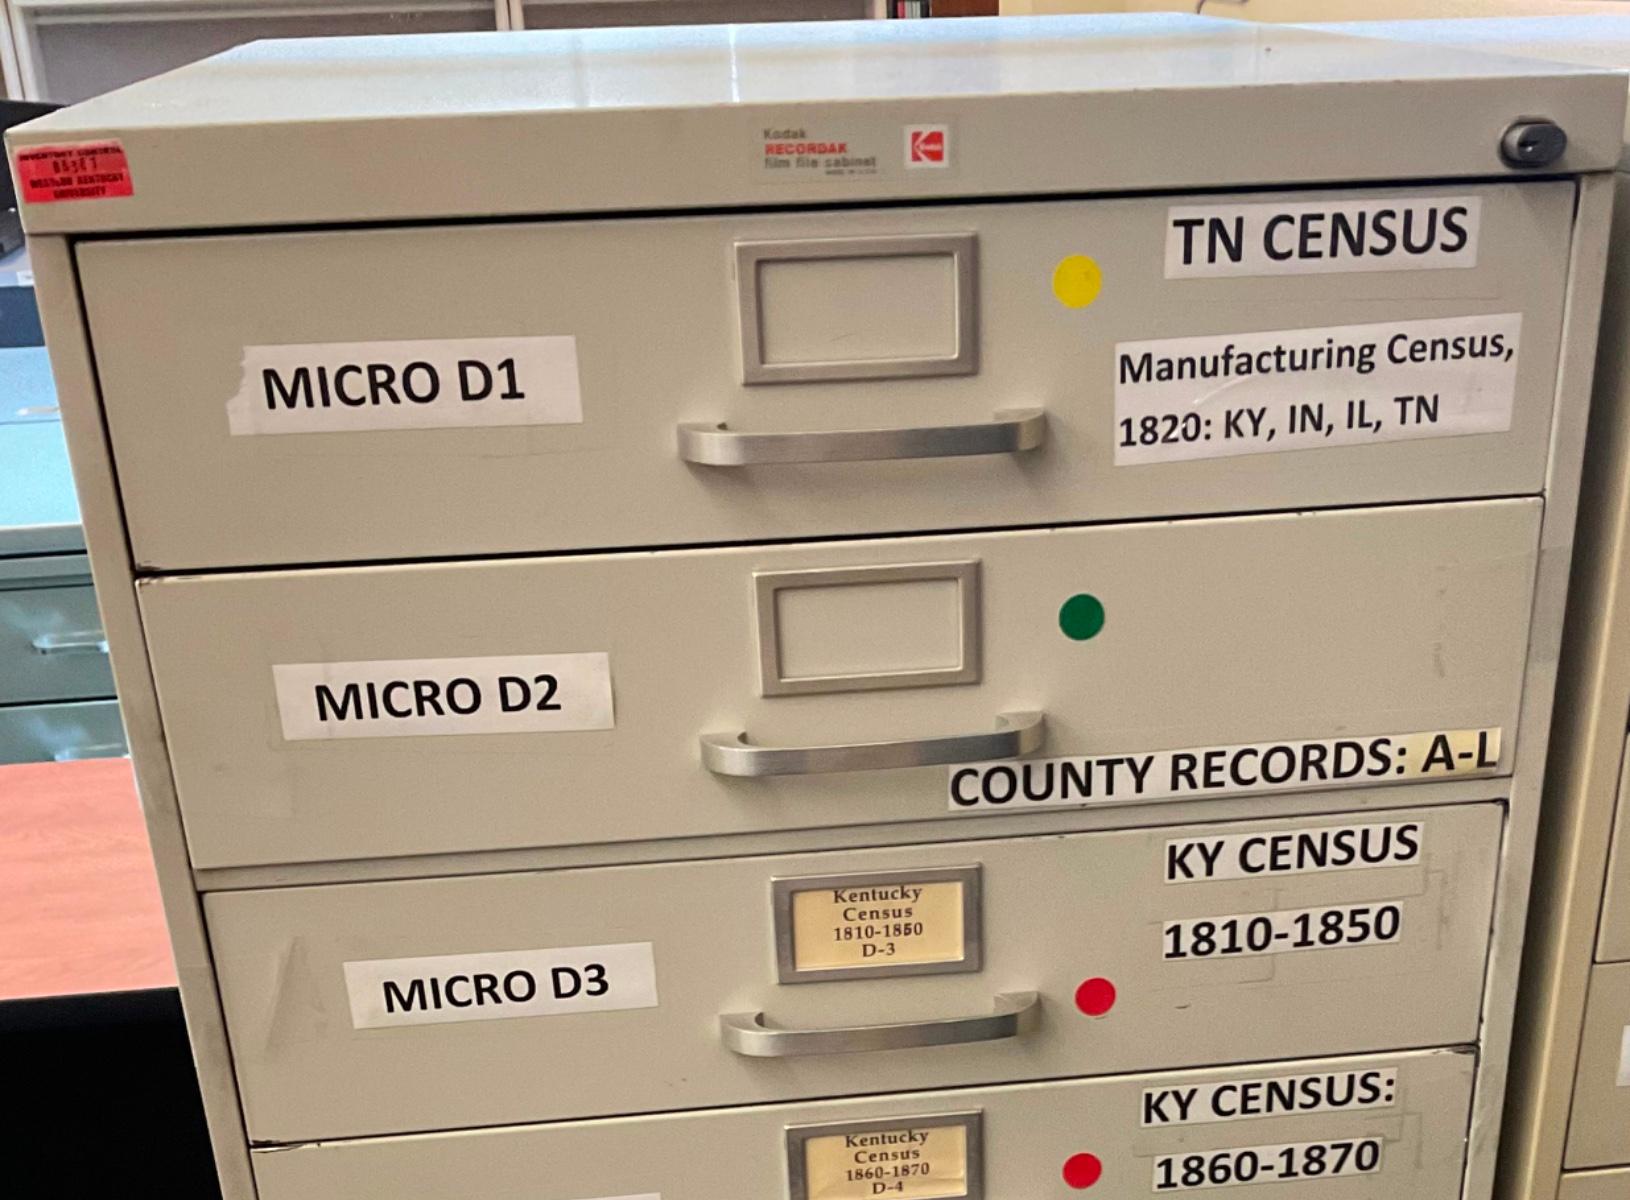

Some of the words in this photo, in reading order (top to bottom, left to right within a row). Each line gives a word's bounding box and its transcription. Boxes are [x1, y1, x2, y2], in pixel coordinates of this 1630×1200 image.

[764, 128, 805, 139] Kodak
[765, 143, 847, 155] RECORDAK
[1173, 216, 1244, 265] TN
[1263, 206, 1468, 261] CENSUS
[1119, 338, 1376, 385] Manufacturing
[1387, 333, 1515, 365] Census,
[262, 361, 440, 410] MICRO
[458, 358, 525, 401] D1
[1119, 412, 1212, 447] 1820:
[1224, 407, 1276, 441] KY,
[1288, 403, 1334, 437] IN,
[1347, 399, 1382, 433] IL,
[1394, 394, 1439, 424] TN
[315, 678, 481, 721] MICRO
[498, 674, 561, 712] D2
[950, 755, 1154, 807] COUNTY
[1170, 737, 1407, 792] RECORDS:
[1422, 730, 1497, 773] A-L
[1167, 840, 1225, 881] KY
[1238, 824, 1419, 874] CENSUS
[833, 886, 922, 903] Kentucky
[843, 907, 913, 922] Census
[862, 943, 895, 957] D-3
[1164, 905, 1400, 959] 1810-1850
[383, 970, 536, 1013] MICRO
[551, 963, 609, 999] D3
[1143, 1088, 1198, 1124] KY
[1211, 1072, 1395, 1117] CENSUS:
[845, 1129, 929, 1148] Kentucky
[854, 1149, 920, 1164] Census
[847, 1163, 930, 1181] 1860-1870
[872, 1181, 904, 1195] D-4
[1157, 1140, 1380, 1189] 1860-1870
